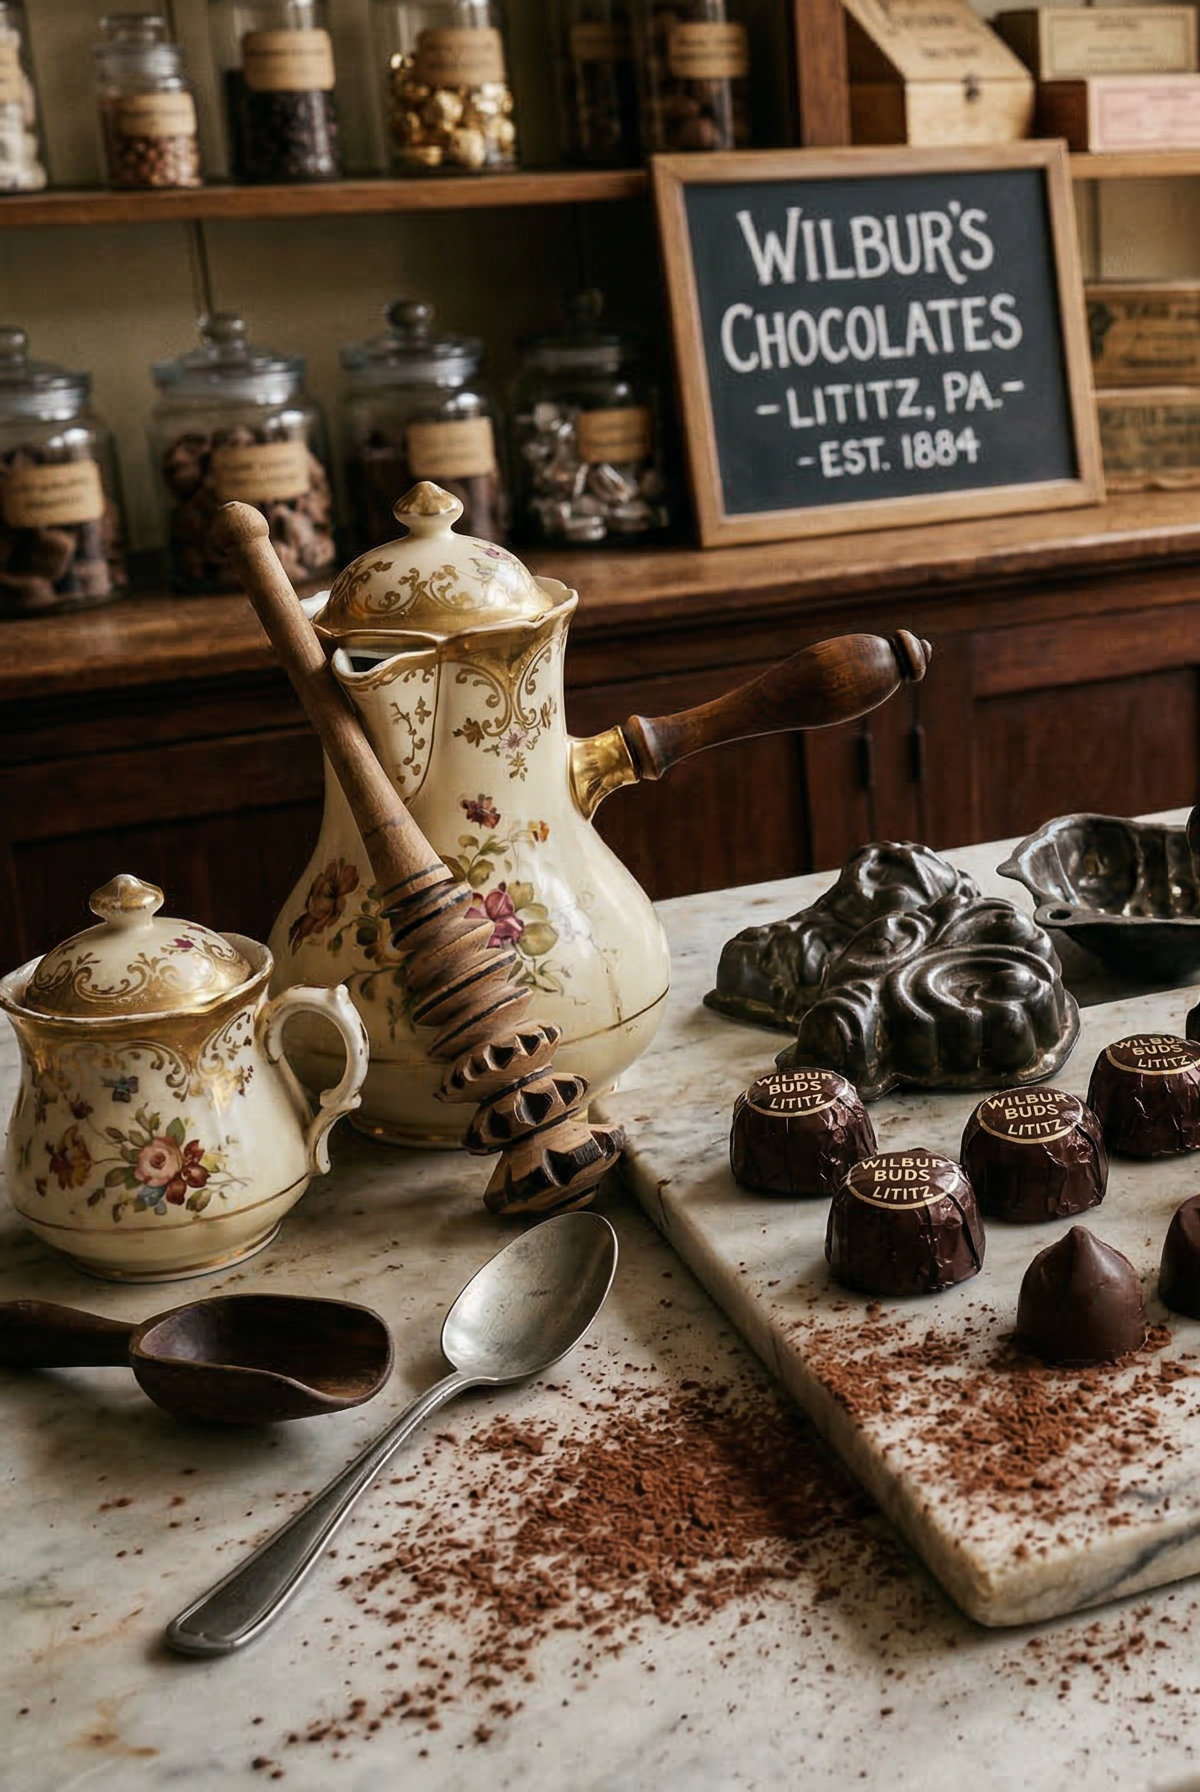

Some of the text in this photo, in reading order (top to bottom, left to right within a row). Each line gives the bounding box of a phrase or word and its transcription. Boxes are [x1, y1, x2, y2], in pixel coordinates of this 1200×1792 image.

[736, 201, 994, 285] WILBUR'S
[721, 293, 1023, 373] CHOCOLATES
[901, 426, 981, 470] 1884
[1137, 1055, 1190, 1068] LITITZ
[769, 1081, 822, 1095] BUDS
[769, 1094, 826, 1110] LITITZ
[987, 1093, 1069, 1110] WILBUR
[1004, 1104, 1059, 1120] BUDS
[1007, 1119, 1066, 1136] LITITZ
[874, 1169, 931, 1182] BUDS
[872, 1185, 934, 1200] LITITZ
